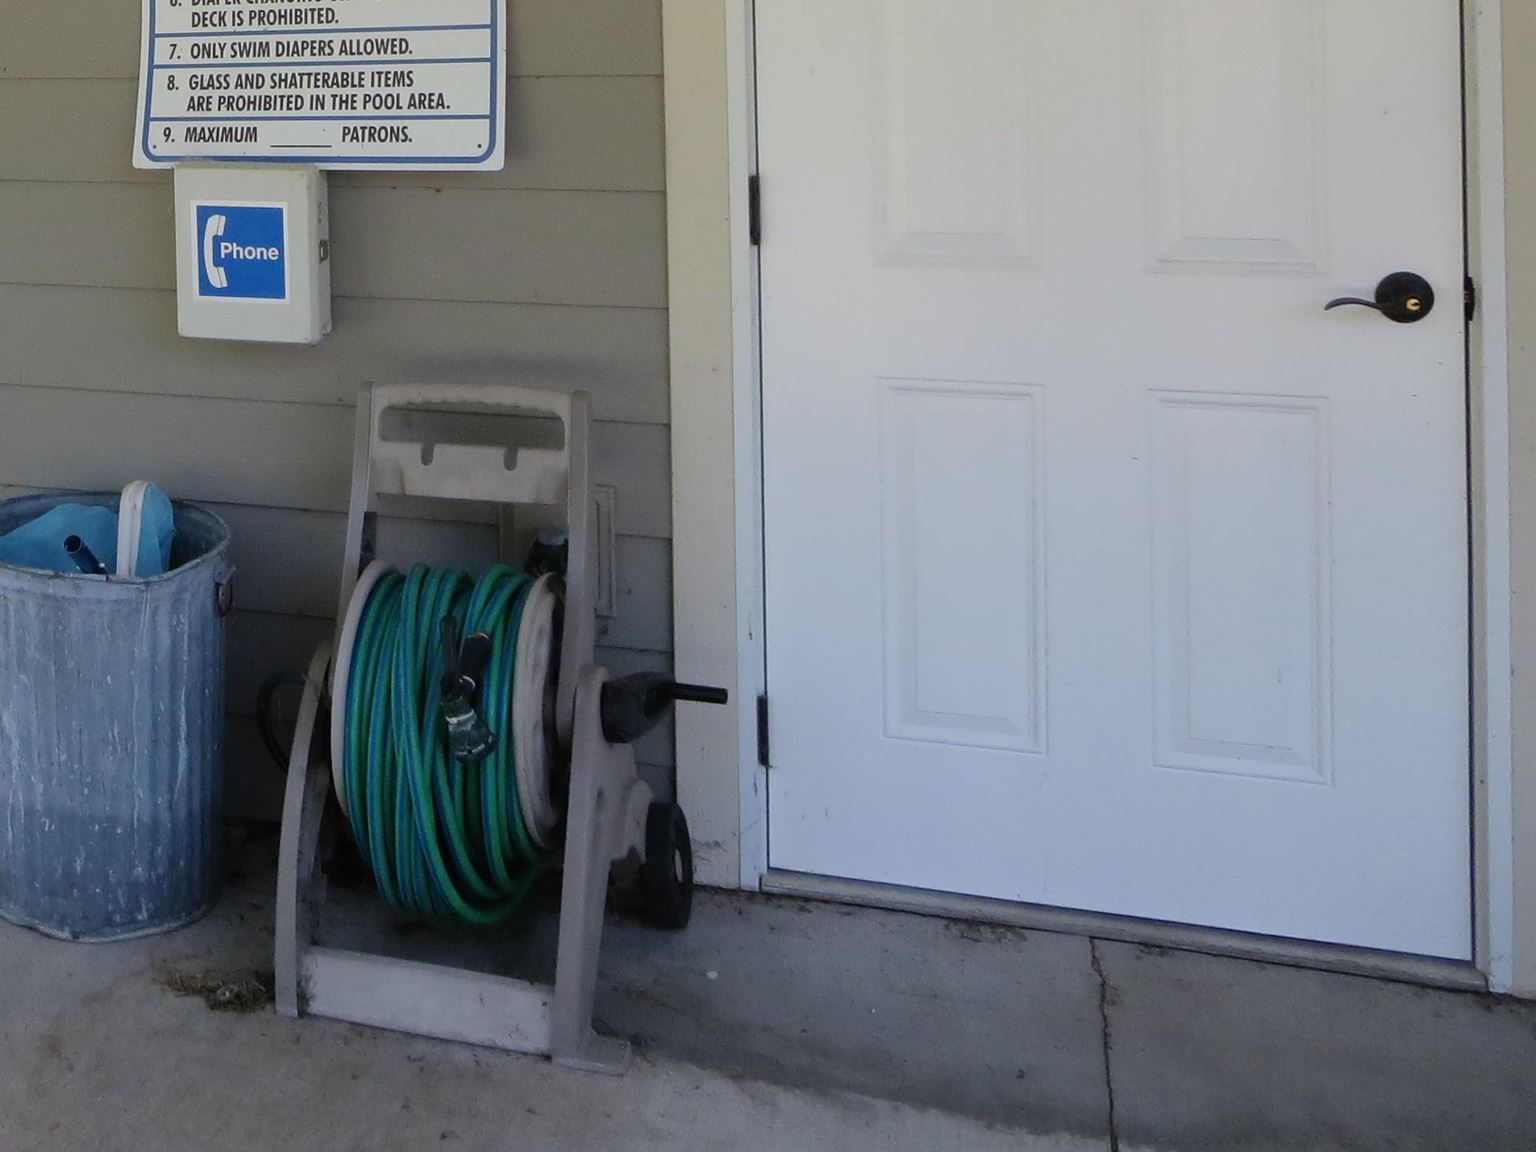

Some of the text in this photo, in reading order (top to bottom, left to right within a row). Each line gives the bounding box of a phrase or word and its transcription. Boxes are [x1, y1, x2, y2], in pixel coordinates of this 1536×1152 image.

[191, 7, 339, 27] DECK IS PROHIBITED.
[169, 37, 413, 59] 7. ONLY SWIM DIAPERS ALLOWED.
[167, 70, 414, 90] 8. GLASS AND SHATTERABLE ITEMS
[187, 92, 450, 111] ARE PROHIBITED IN THE POOL AREA.
[163, 126, 412, 143] 9. MAXIMUM PATRONS.
[220, 242, 279, 260] Phone
